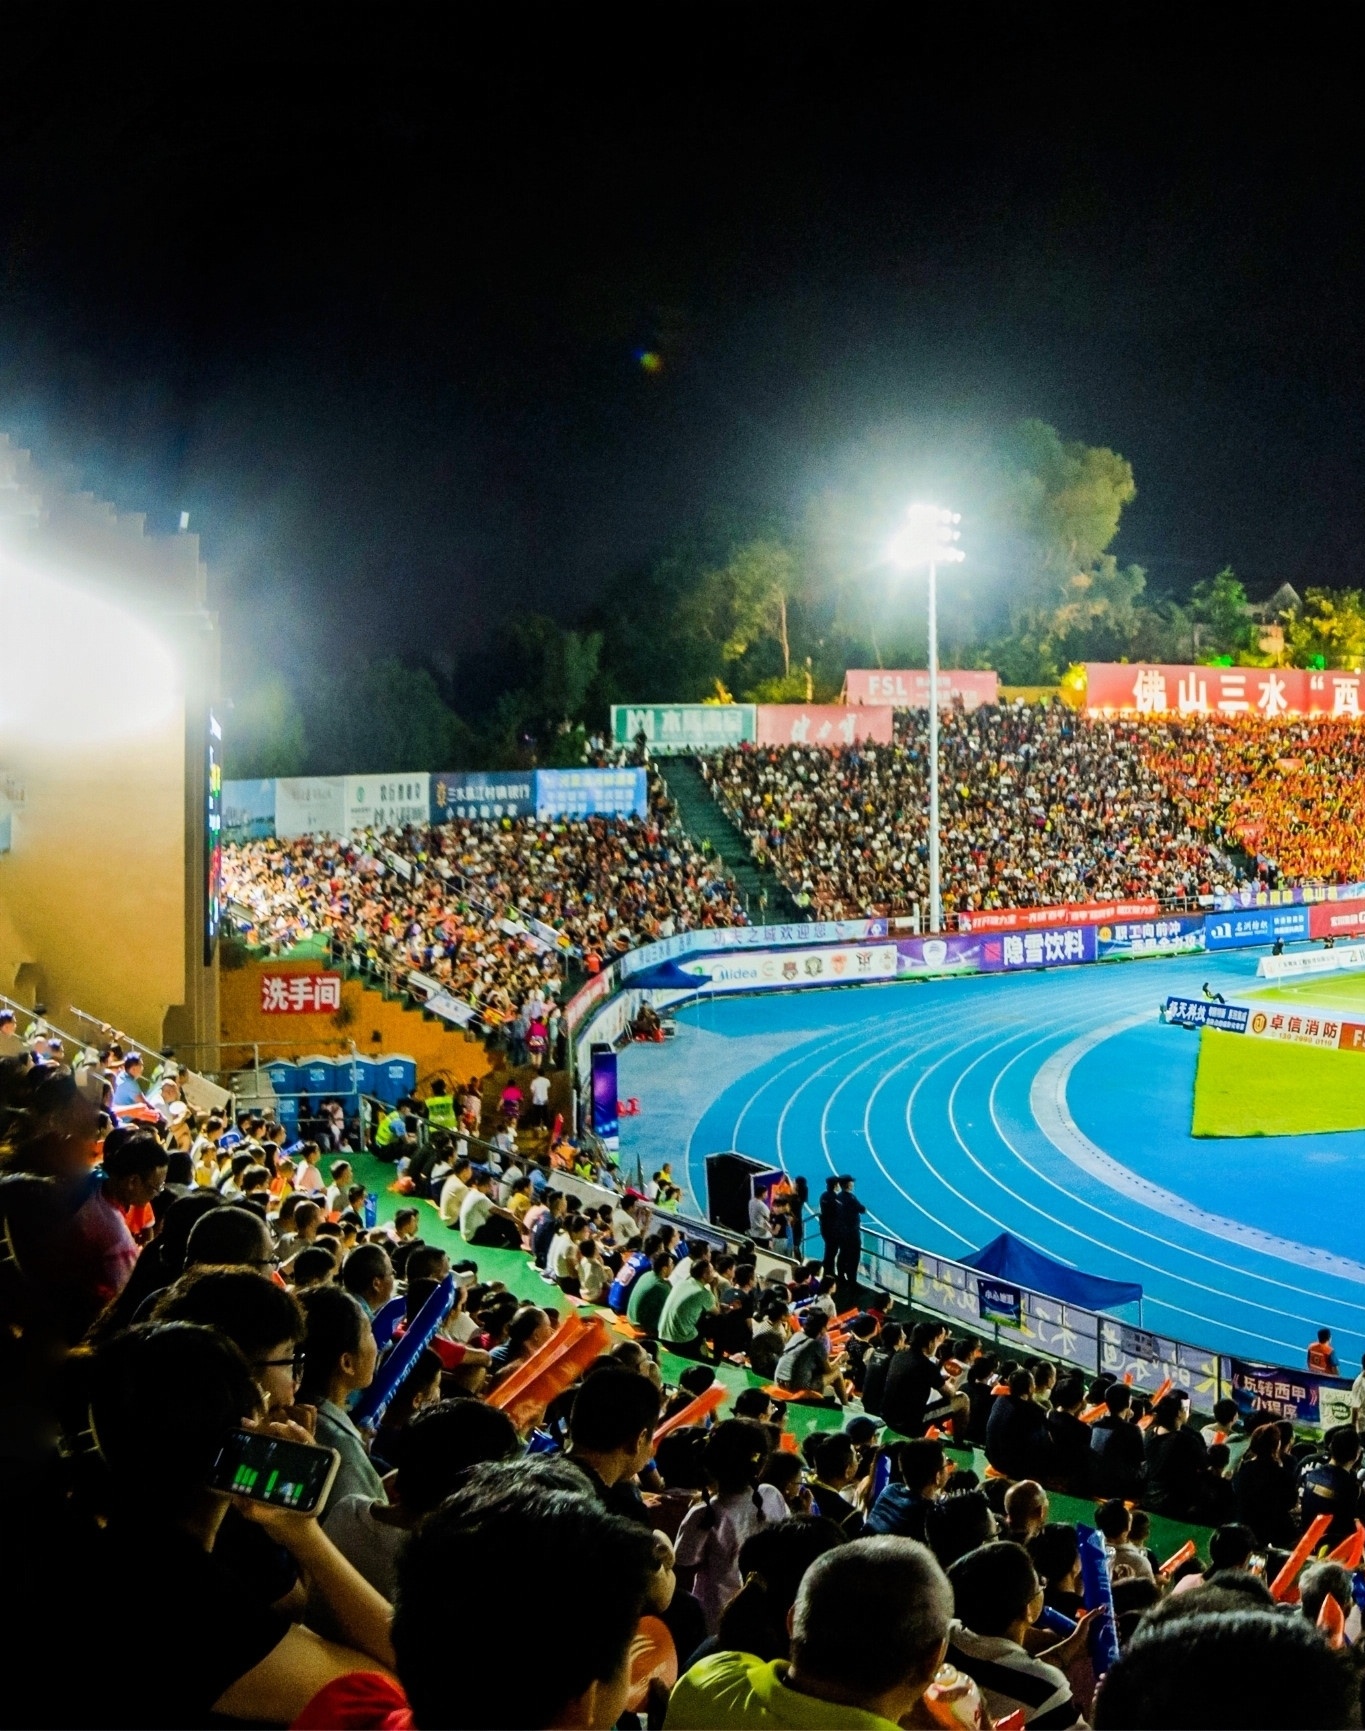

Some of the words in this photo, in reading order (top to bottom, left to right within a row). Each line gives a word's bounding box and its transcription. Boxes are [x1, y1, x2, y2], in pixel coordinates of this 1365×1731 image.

[868, 675, 907, 697] FSL
[1115, 920, 1182, 941] 职工向前冲
[1003, 928, 1084, 966] 隐雪饮料
[718, 967, 757, 981] Midea
[262, 976, 341, 1011] 洗手间
[1269, 1014, 1339, 1039] 卓信消防
[1251, 1396, 1298, 1420] 小程序
